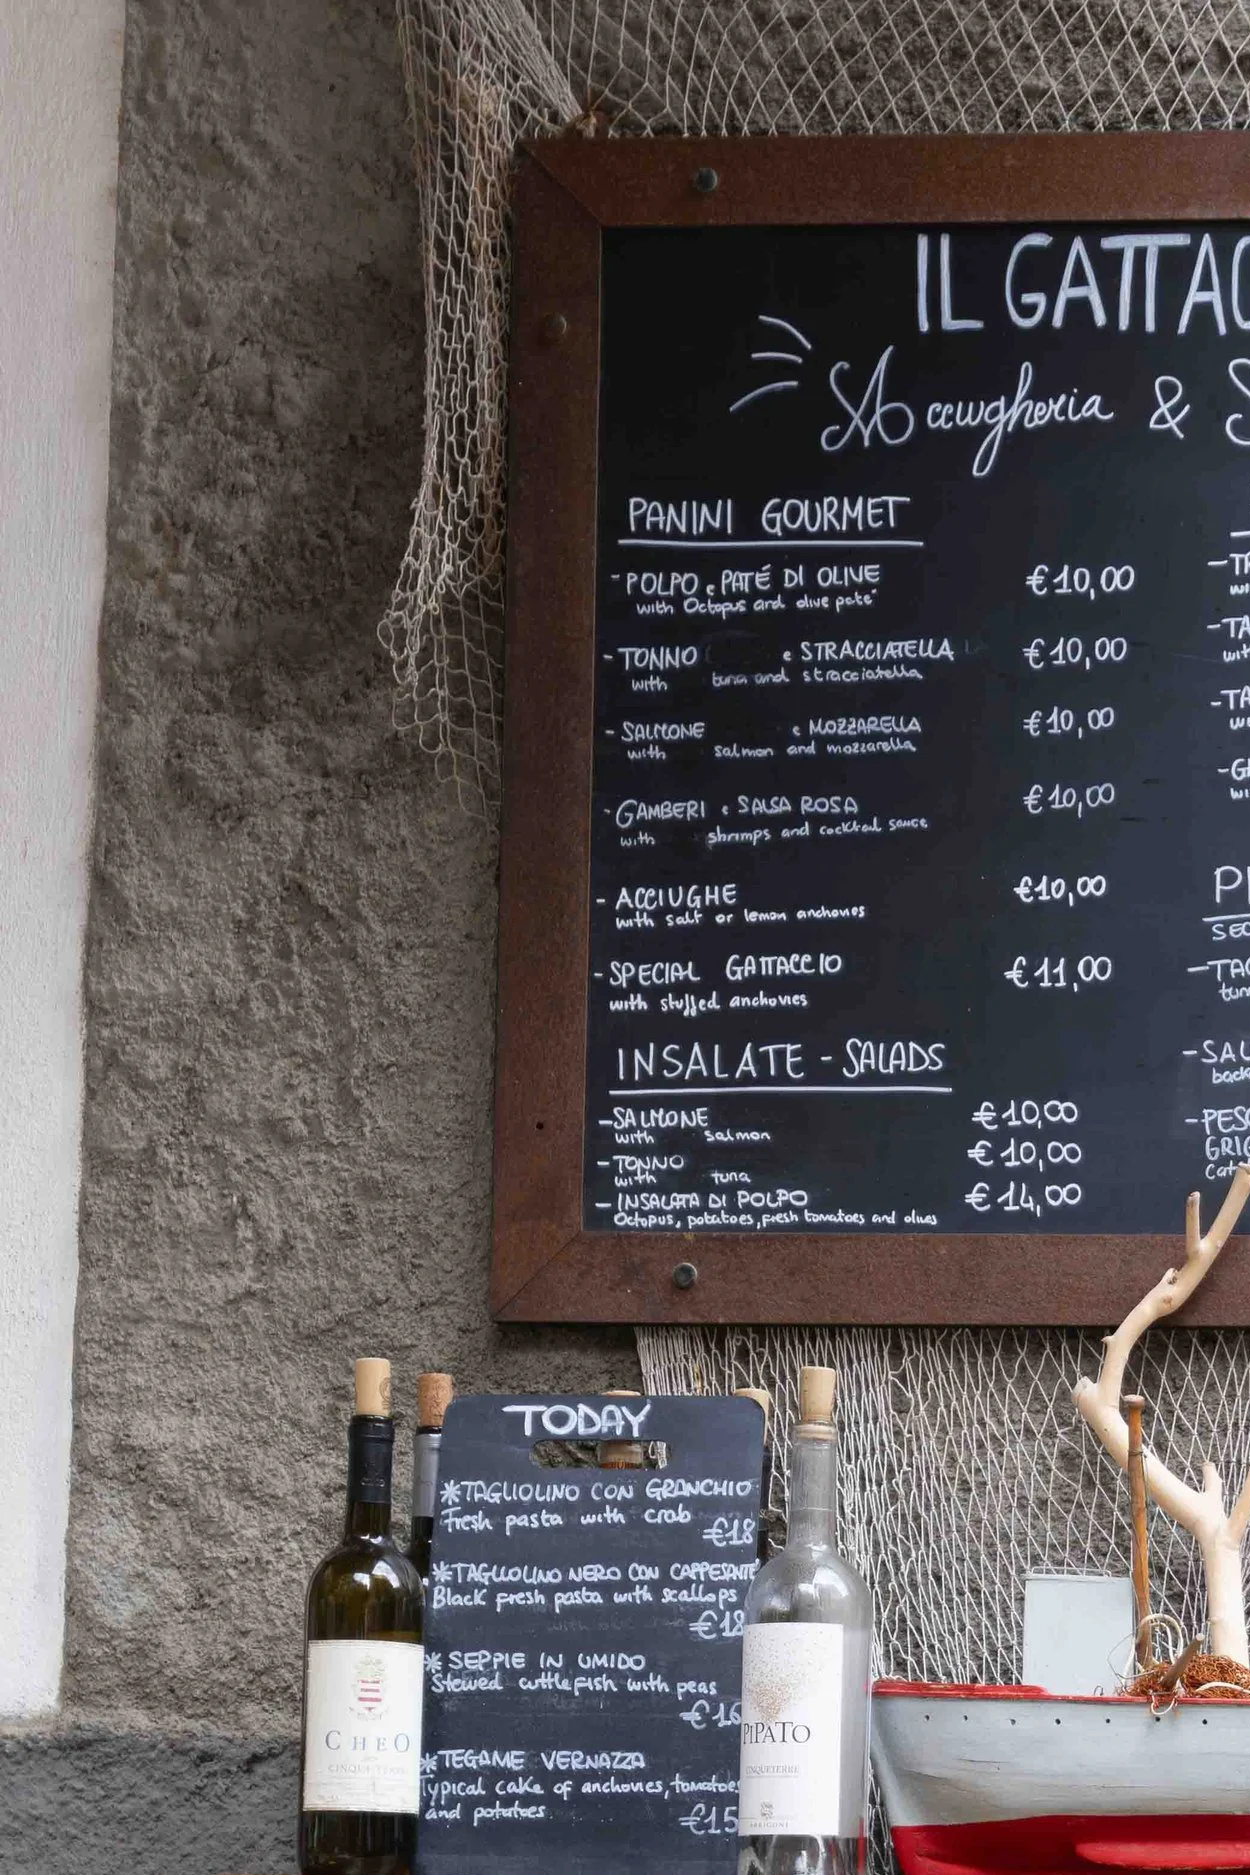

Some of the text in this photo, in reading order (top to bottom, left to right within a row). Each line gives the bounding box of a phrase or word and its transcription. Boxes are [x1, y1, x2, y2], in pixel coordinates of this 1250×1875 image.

[917, 233, 984, 333] IL
[1149, 375, 1191, 439] &
[629, 495, 911, 537] PANINI GOURMET
[626, 563, 1135, 601] POLPO PATÉ DI OLIVE €10,00
[636, 593, 829, 620] with Octopus and olive
[617, 636, 1128, 671] TONNO STRACCIATELLA €10,00
[631, 666, 790, 692] with and
[621, 705, 1115, 742] SALMONE MOZZARELLA €10,00
[627, 740, 816, 760] with salmon and
[615, 782, 1115, 829] GAMBERI SALSA ROSA €10,00
[620, 820, 810, 847] with and
[615, 874, 1107, 911] ACCIUGHE €10,00
[615, 905, 865, 929] with or lemon anchovies
[609, 960, 701, 989] SPECIAL
[725, 952, 842, 981] GATTACCIO
[609, 993, 648, 1011] with
[729, 990, 808, 1008] anchovies
[618, 1037, 946, 1081] INSALATE SALADS
[612, 1106, 709, 1131] SALMONE
[614, 1128, 771, 1145] with salmon
[612, 1154, 685, 1172] TONNO
[614, 1171, 751, 1188] with tuna
[617, 1188, 808, 1212] INSALATA DI POLPO
[501, 1402, 652, 1438] TODAY
[590, 1482, 634, 1501] CON
[645, 1478, 752, 1502] GRANCHIO
[440, 1502, 692, 1536] Fresh pasta with crab
[702, 1516, 756, 1548] €18
[568, 1563, 622, 1582] NERO
[628, 1562, 660, 1582] CON
[554, 1586, 604, 1614] pasta
[613, 1584, 653, 1605] with
[688, 1609, 745, 1640] €18
[448, 1649, 646, 1671] SEPPIE IN UMIDO
[431, 1671, 718, 1701] Stewed with peas
[679, 1699, 742, 1730] €16
[743, 1721, 811, 1745] PIPATO
[437, 1748, 646, 1771] TEGAME VERNAZZA
[424, 1802, 461, 1820] and
[678, 1802, 739, 1836] €15
